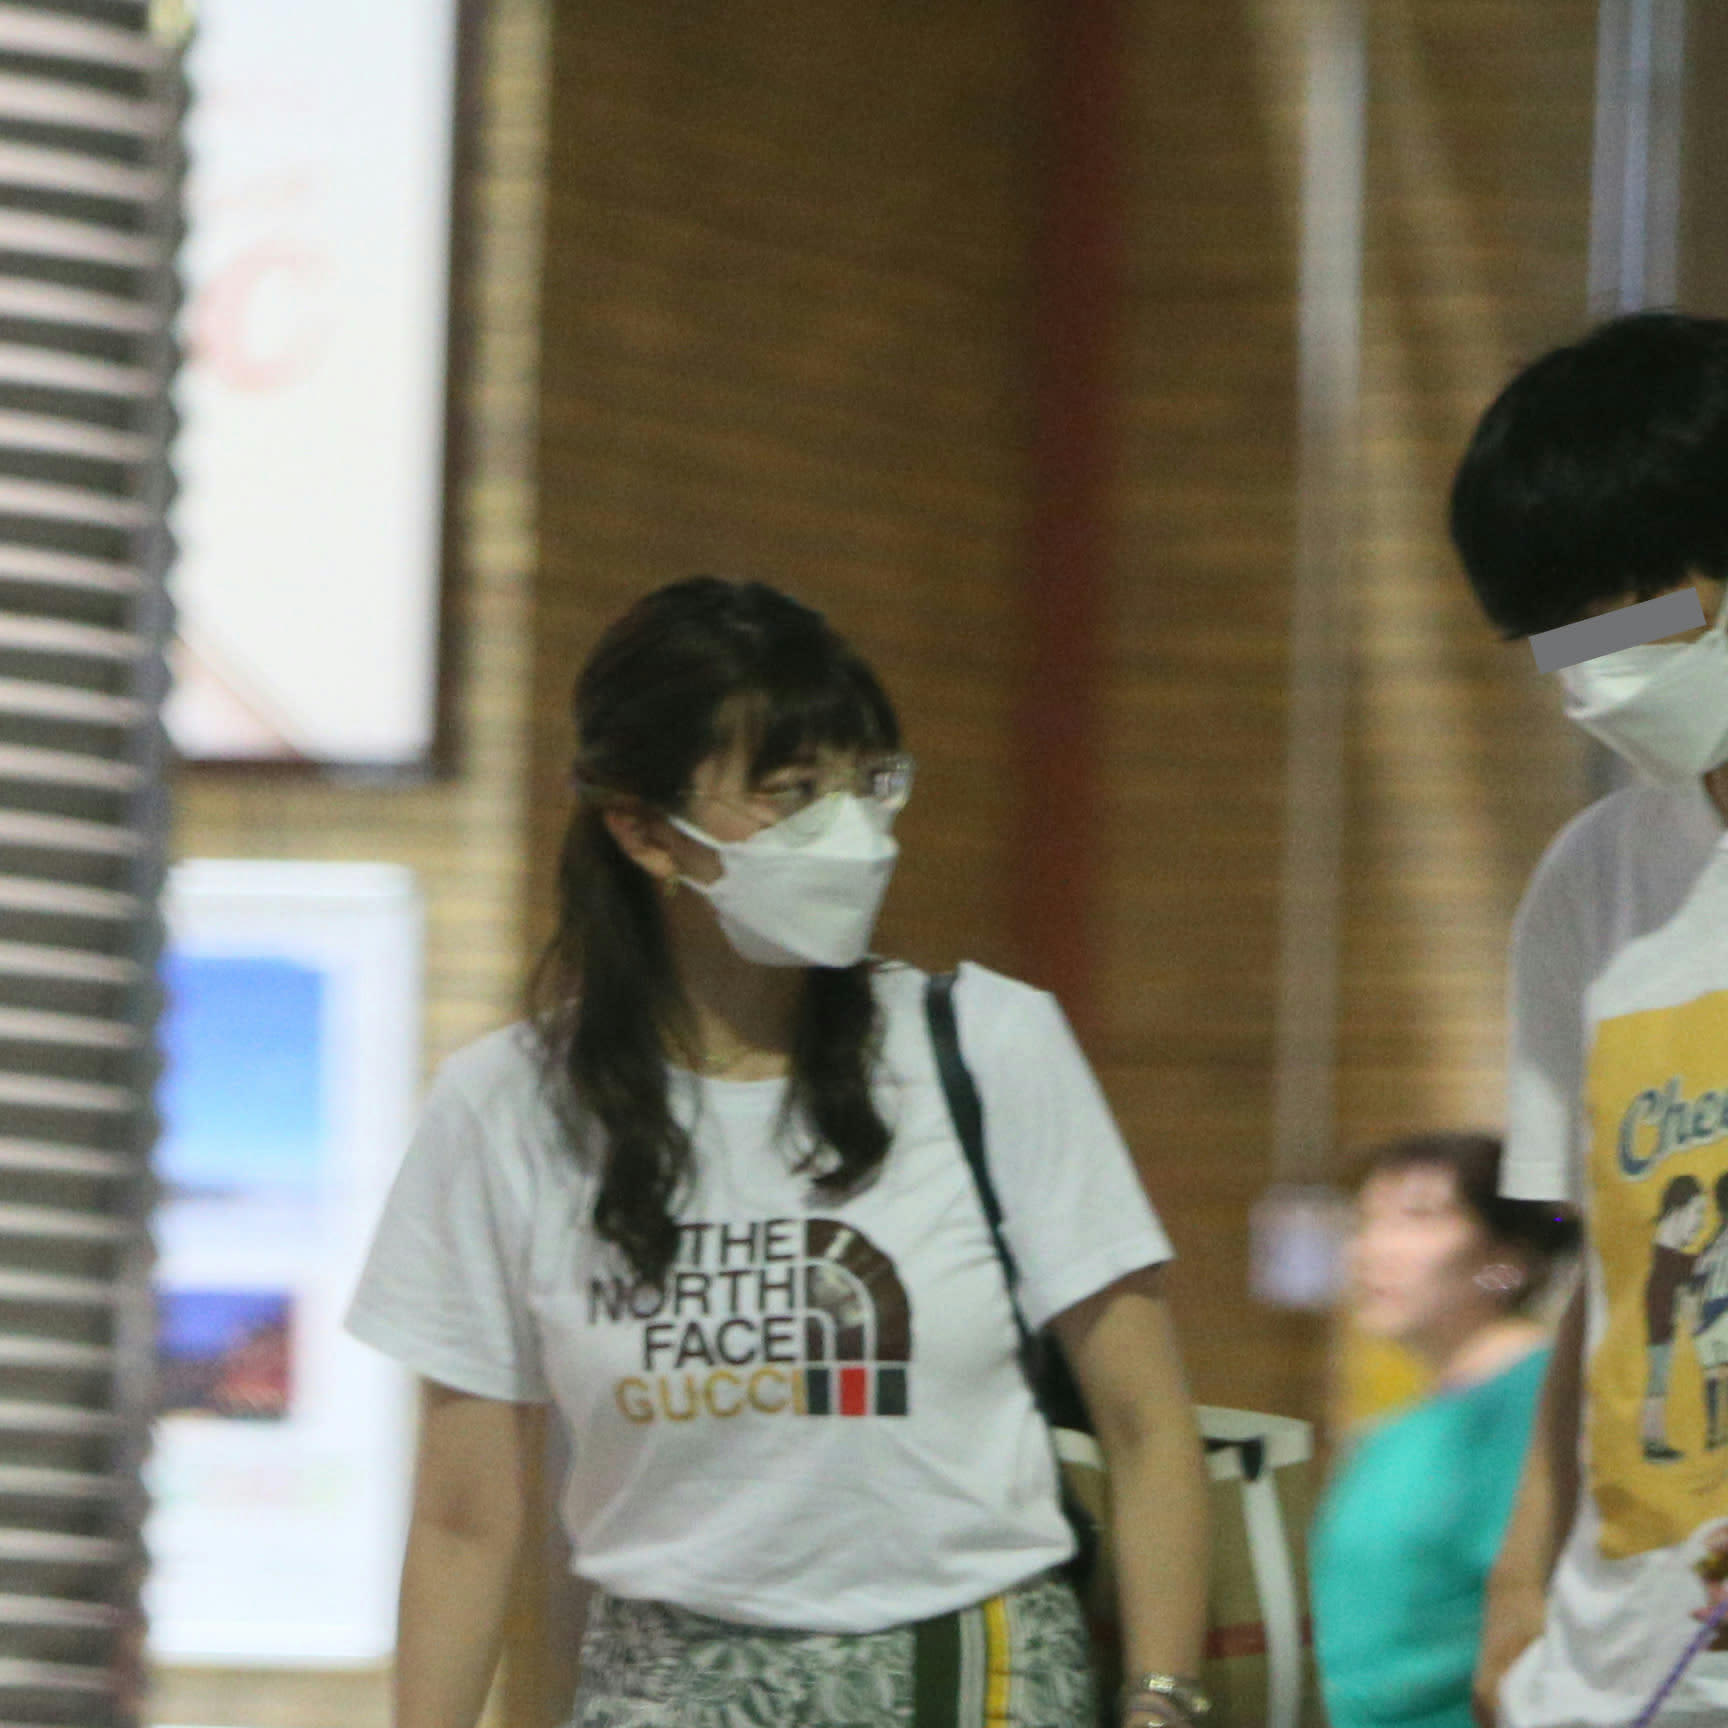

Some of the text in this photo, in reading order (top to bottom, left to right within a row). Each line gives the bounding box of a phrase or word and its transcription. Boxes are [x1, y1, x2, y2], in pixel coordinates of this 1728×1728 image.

[677, 1218, 797, 1266] THE
[586, 1265, 797, 1327] NORTH
[642, 1315, 798, 1371] FACE
[614, 1366, 808, 1426] GUCCI
